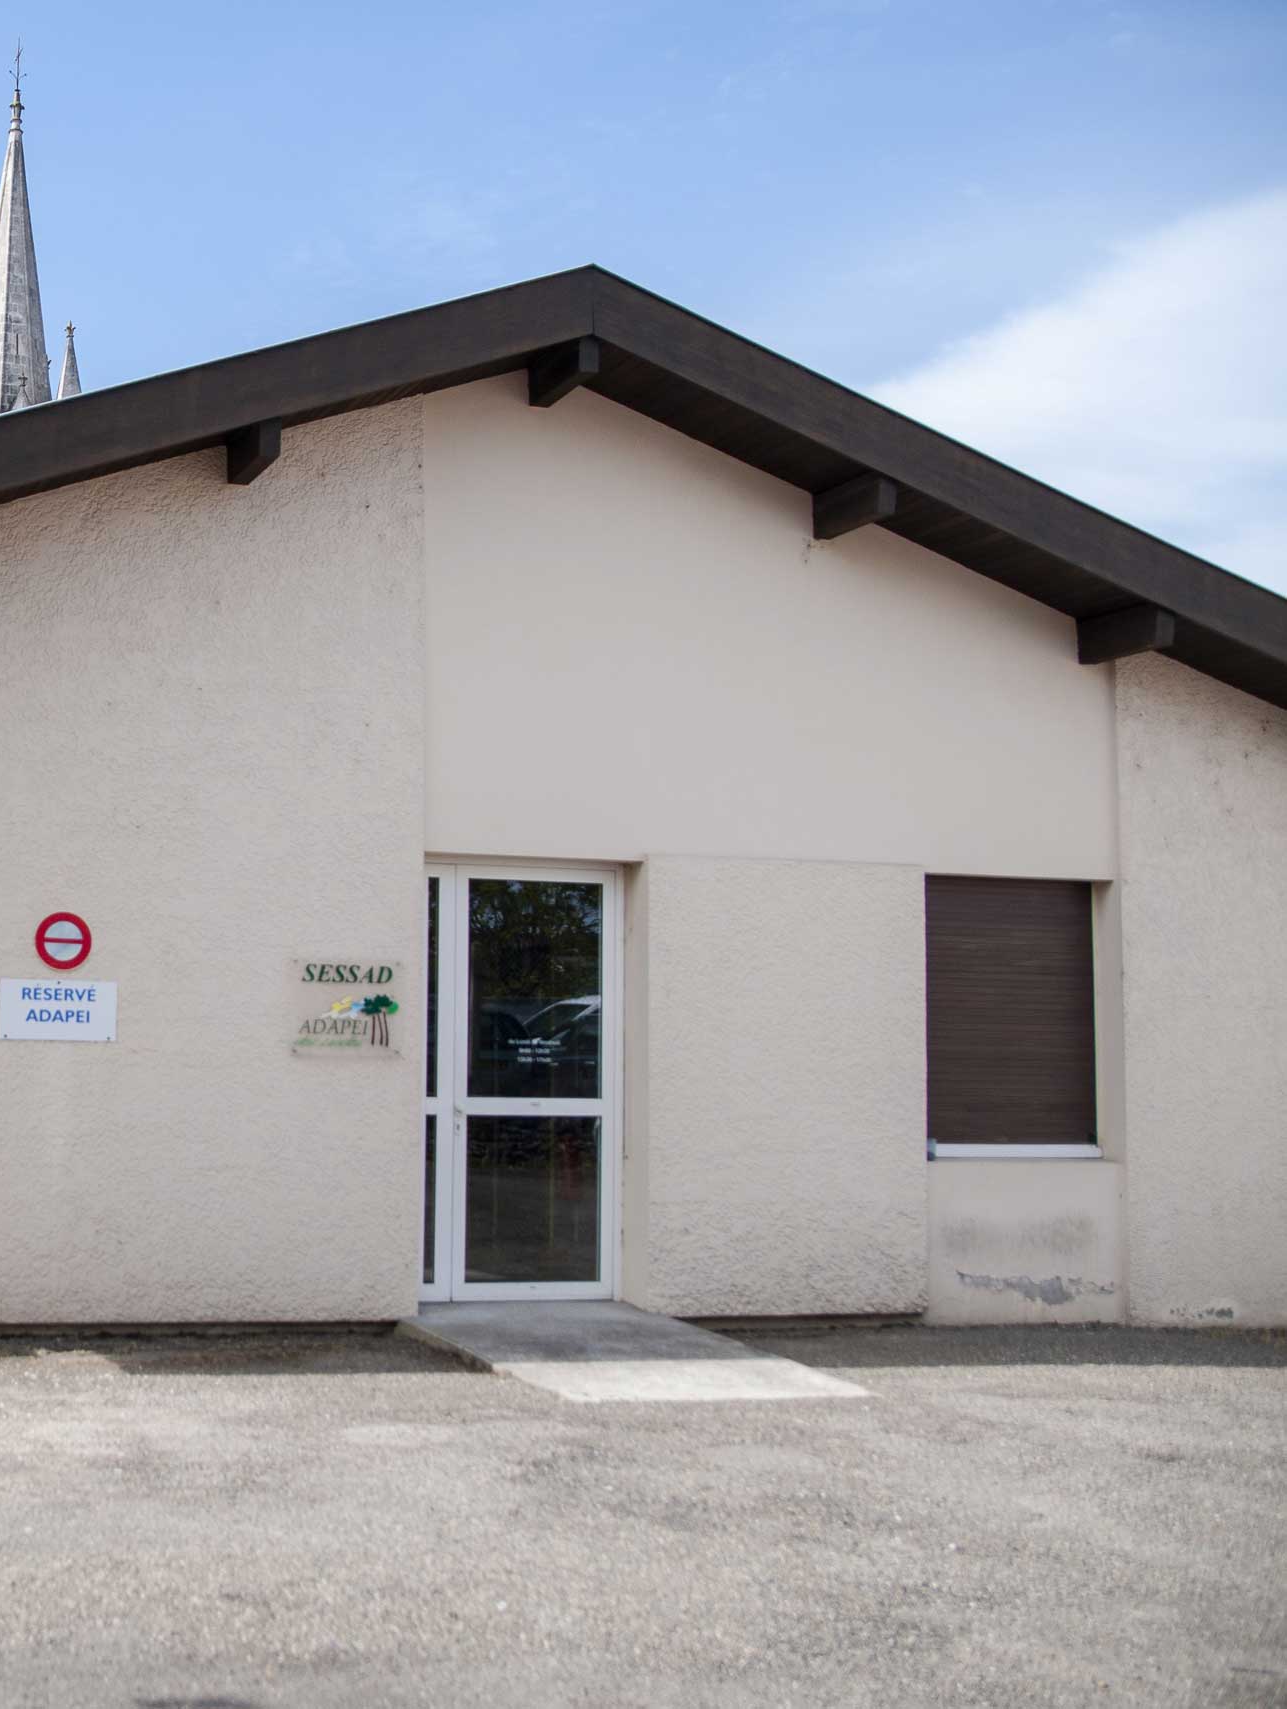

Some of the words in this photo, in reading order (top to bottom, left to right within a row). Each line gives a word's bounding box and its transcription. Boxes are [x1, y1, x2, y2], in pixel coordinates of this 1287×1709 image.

[302, 963, 393, 984] SESSAD
[25, 1009, 91, 1023] ADAPEI
[298, 1018, 368, 1035] ADAPEI
